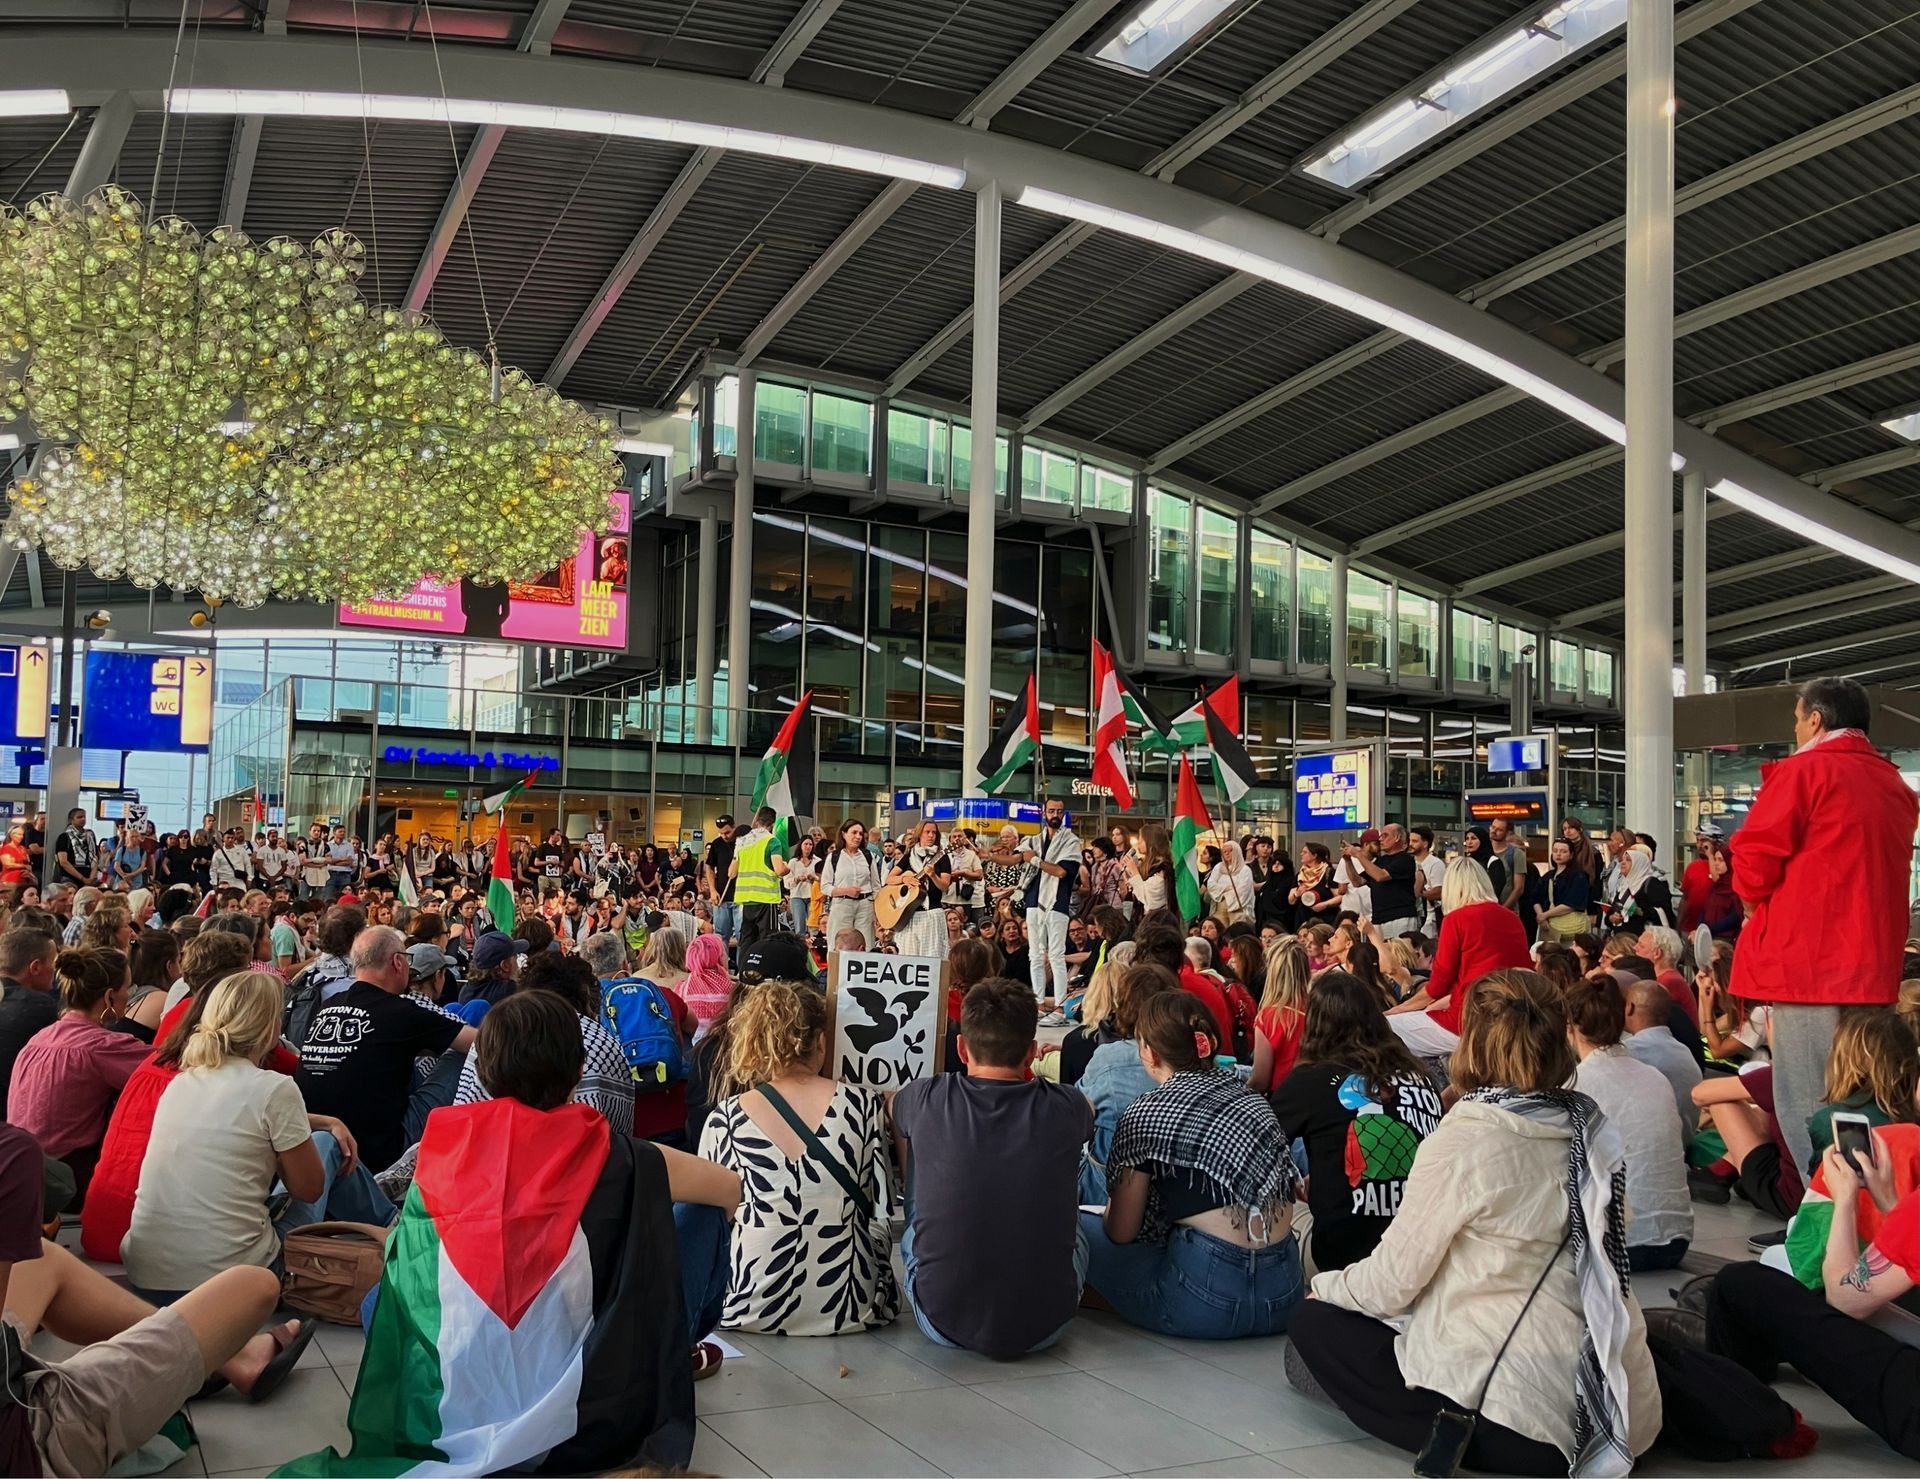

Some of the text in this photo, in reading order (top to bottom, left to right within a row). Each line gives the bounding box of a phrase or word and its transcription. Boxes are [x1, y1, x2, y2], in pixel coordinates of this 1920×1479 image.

[581, 579, 614, 599] LAAT
[581, 598, 617, 619] MEER
[580, 616, 609, 636] ZIEN
[155, 701, 177, 711] WC
[384, 746, 412, 763] OV
[416, 747, 479, 767] Service
[483, 751, 497, 768] &
[847, 960, 930, 987] PEACE
[842, 1055, 924, 1086] NOW
